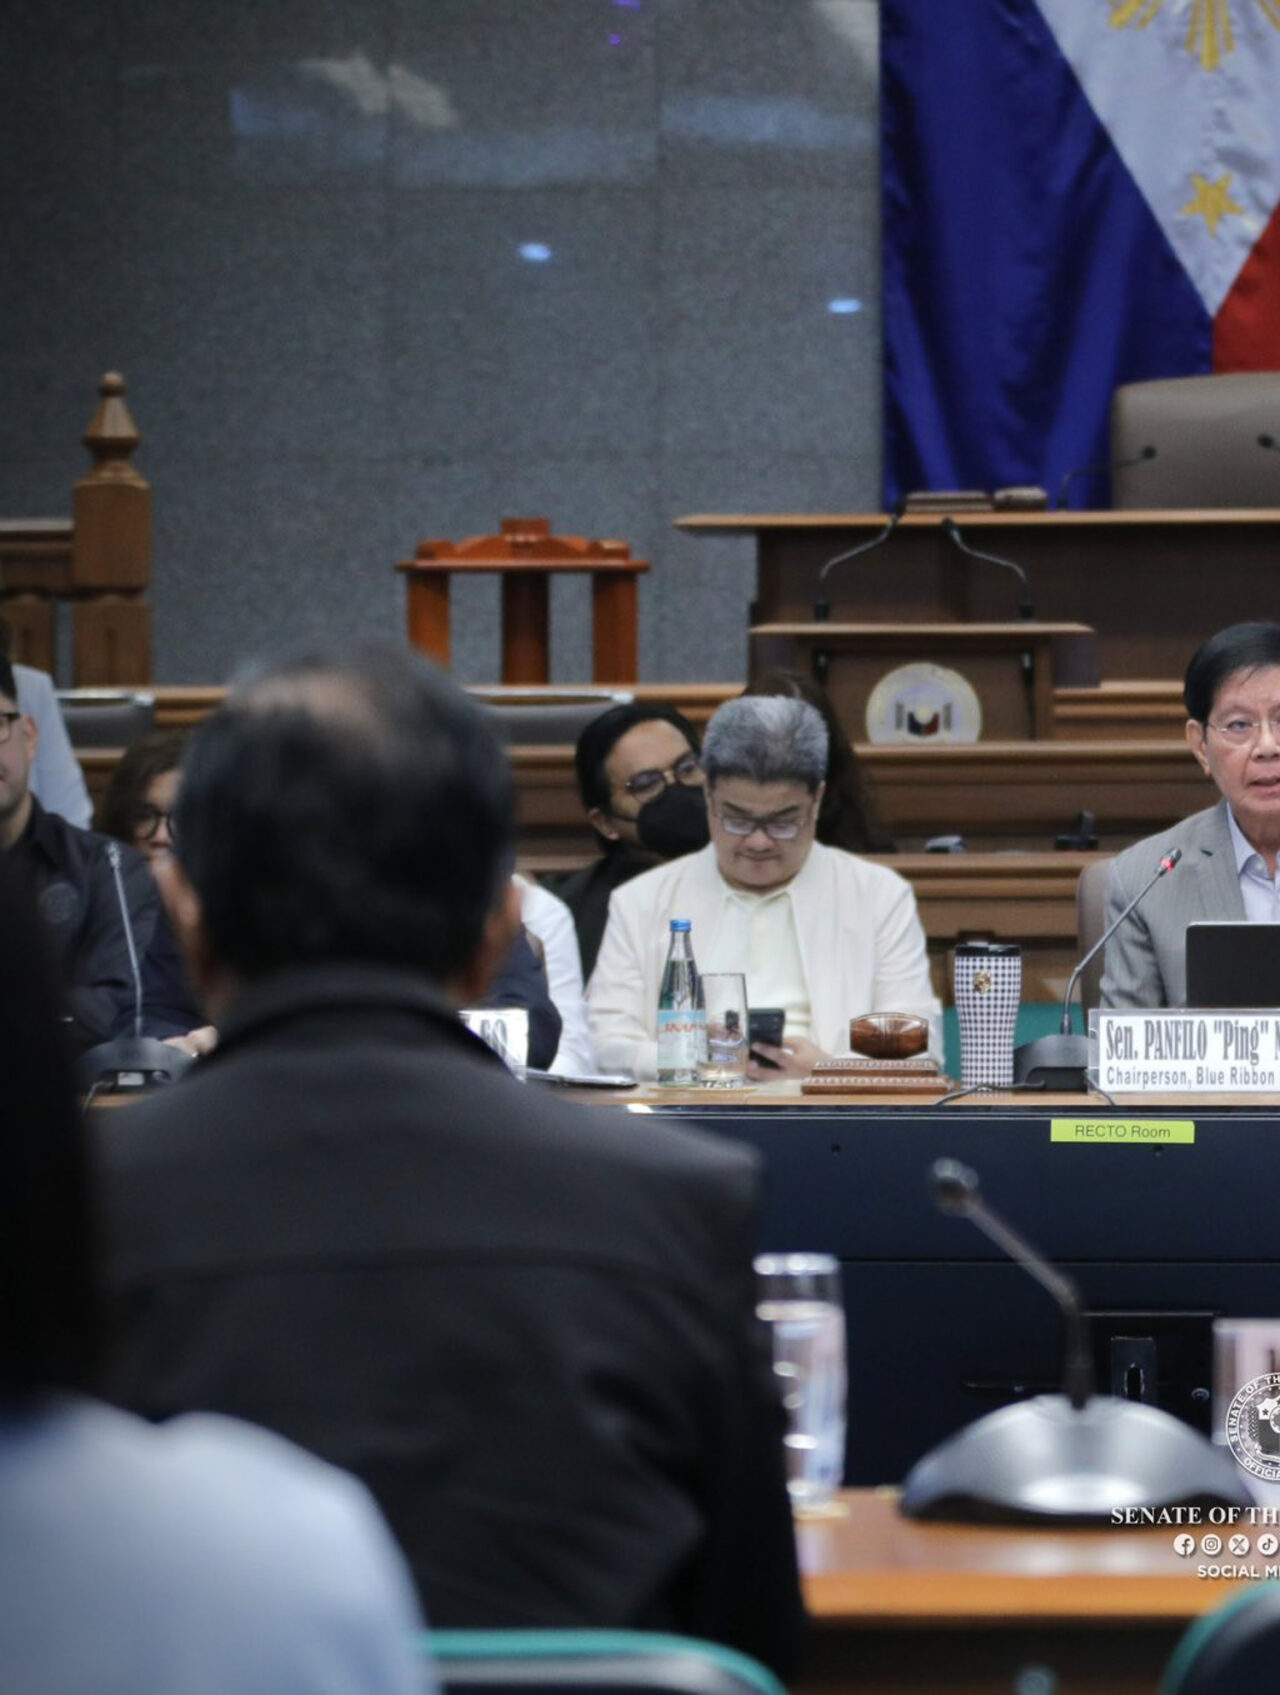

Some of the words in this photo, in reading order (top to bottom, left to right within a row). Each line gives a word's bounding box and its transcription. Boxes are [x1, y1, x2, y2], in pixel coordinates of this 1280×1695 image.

[1106, 1020, 1138, 1060] Sen.
[1144, 1020, 1207, 1060] PANFILO
[1214, 1019, 1269, 1066] "Ping"
[1106, 1066, 1191, 1089] Chairperson,
[1196, 1066, 1224, 1084] Blue
[1230, 1066, 1274, 1084] Ribbon
[1075, 1125, 1127, 1137] RECTO
[1131, 1125, 1170, 1138] Room
